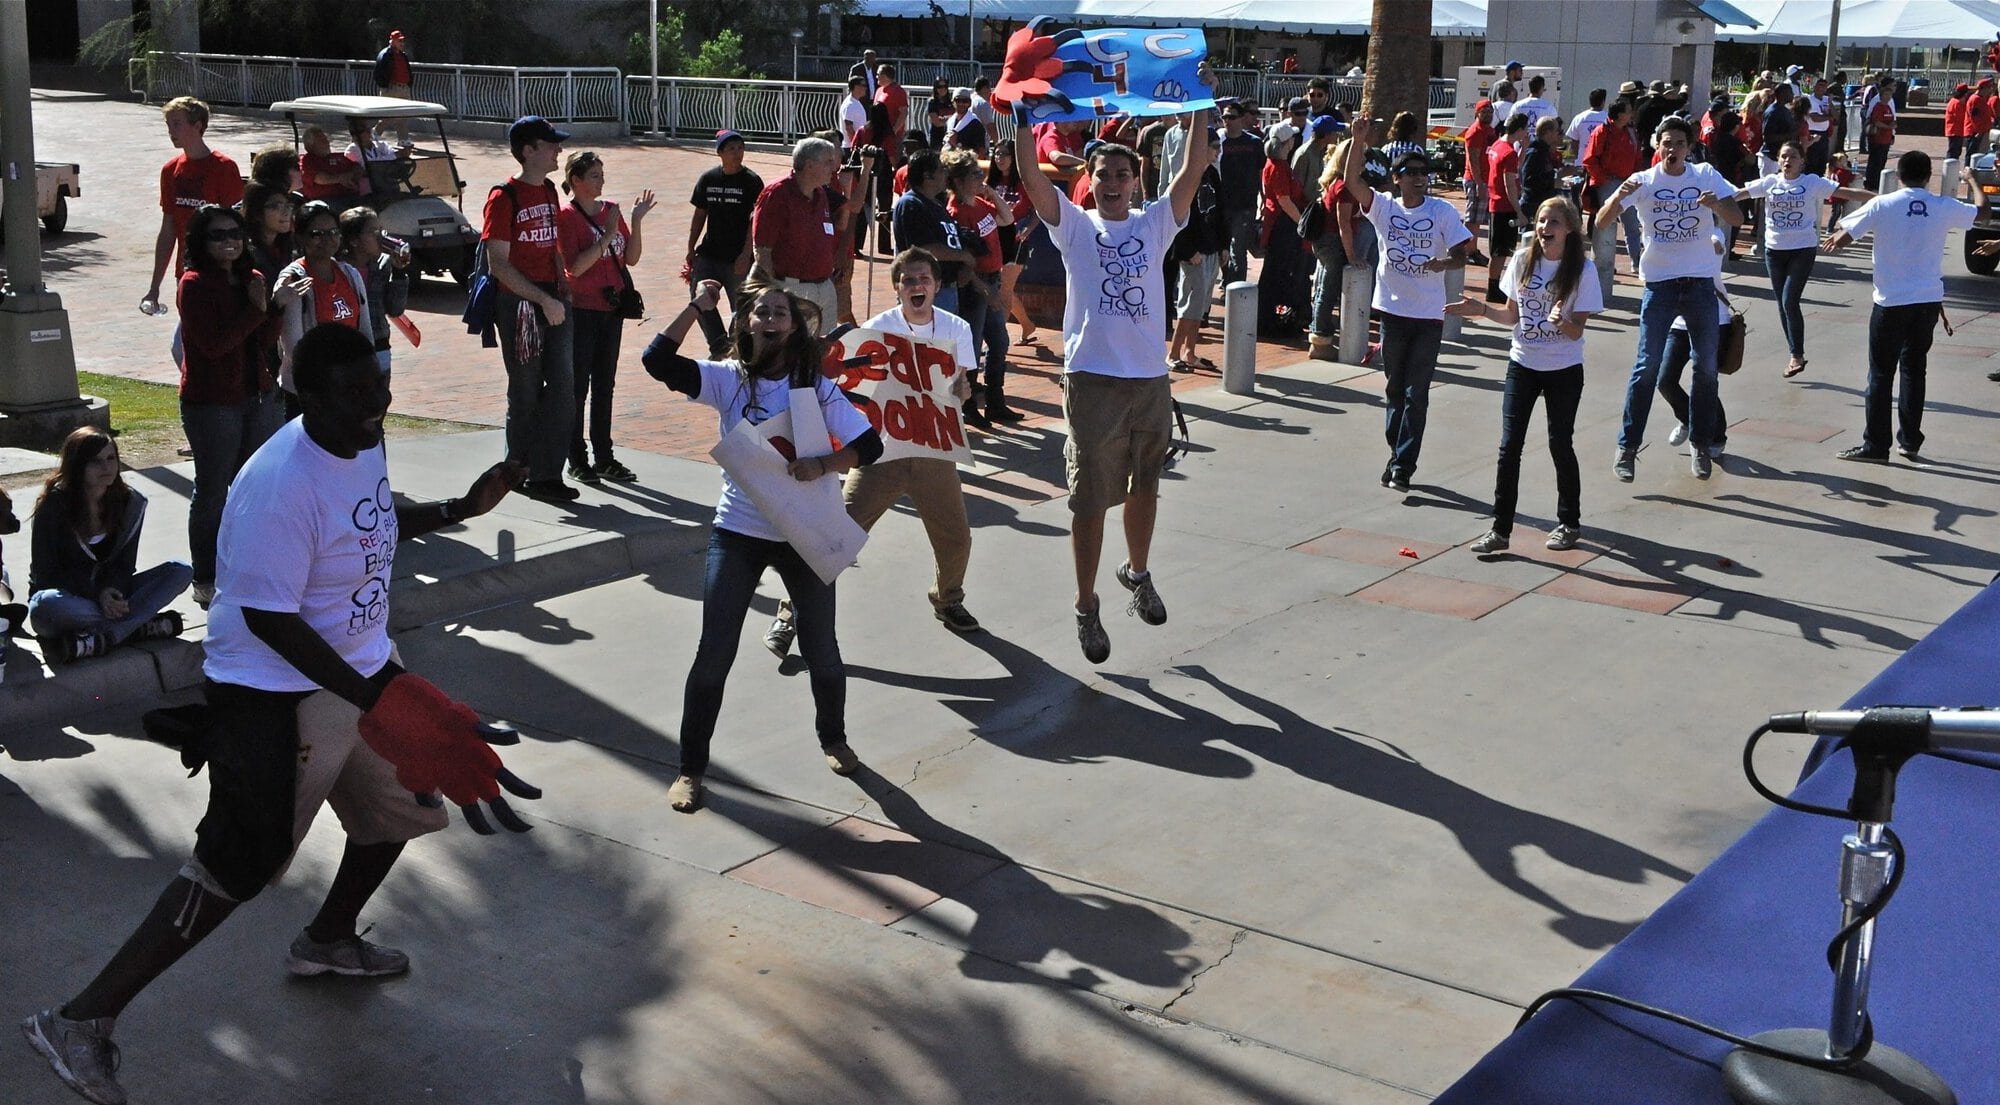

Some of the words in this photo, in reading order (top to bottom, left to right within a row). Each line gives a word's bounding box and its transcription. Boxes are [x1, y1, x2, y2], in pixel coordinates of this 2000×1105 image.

[1654, 187, 1701, 201] GO
[1390, 215, 1434, 231] GO
[1654, 216, 1700, 232] GO
[1772, 211, 1804, 221] GO
[1388, 231, 1432, 249] BOLD
[1654, 228, 1698, 240] HOME
[1097, 248, 1119, 261] ED,
[1387, 247, 1431, 266] GO
[1112, 276, 1132, 287] OR
[1102, 278, 1145, 306] GO
[333, 298, 353, 320] A
[352, 477, 394, 533] GO
[365, 527, 399, 576] BOL
